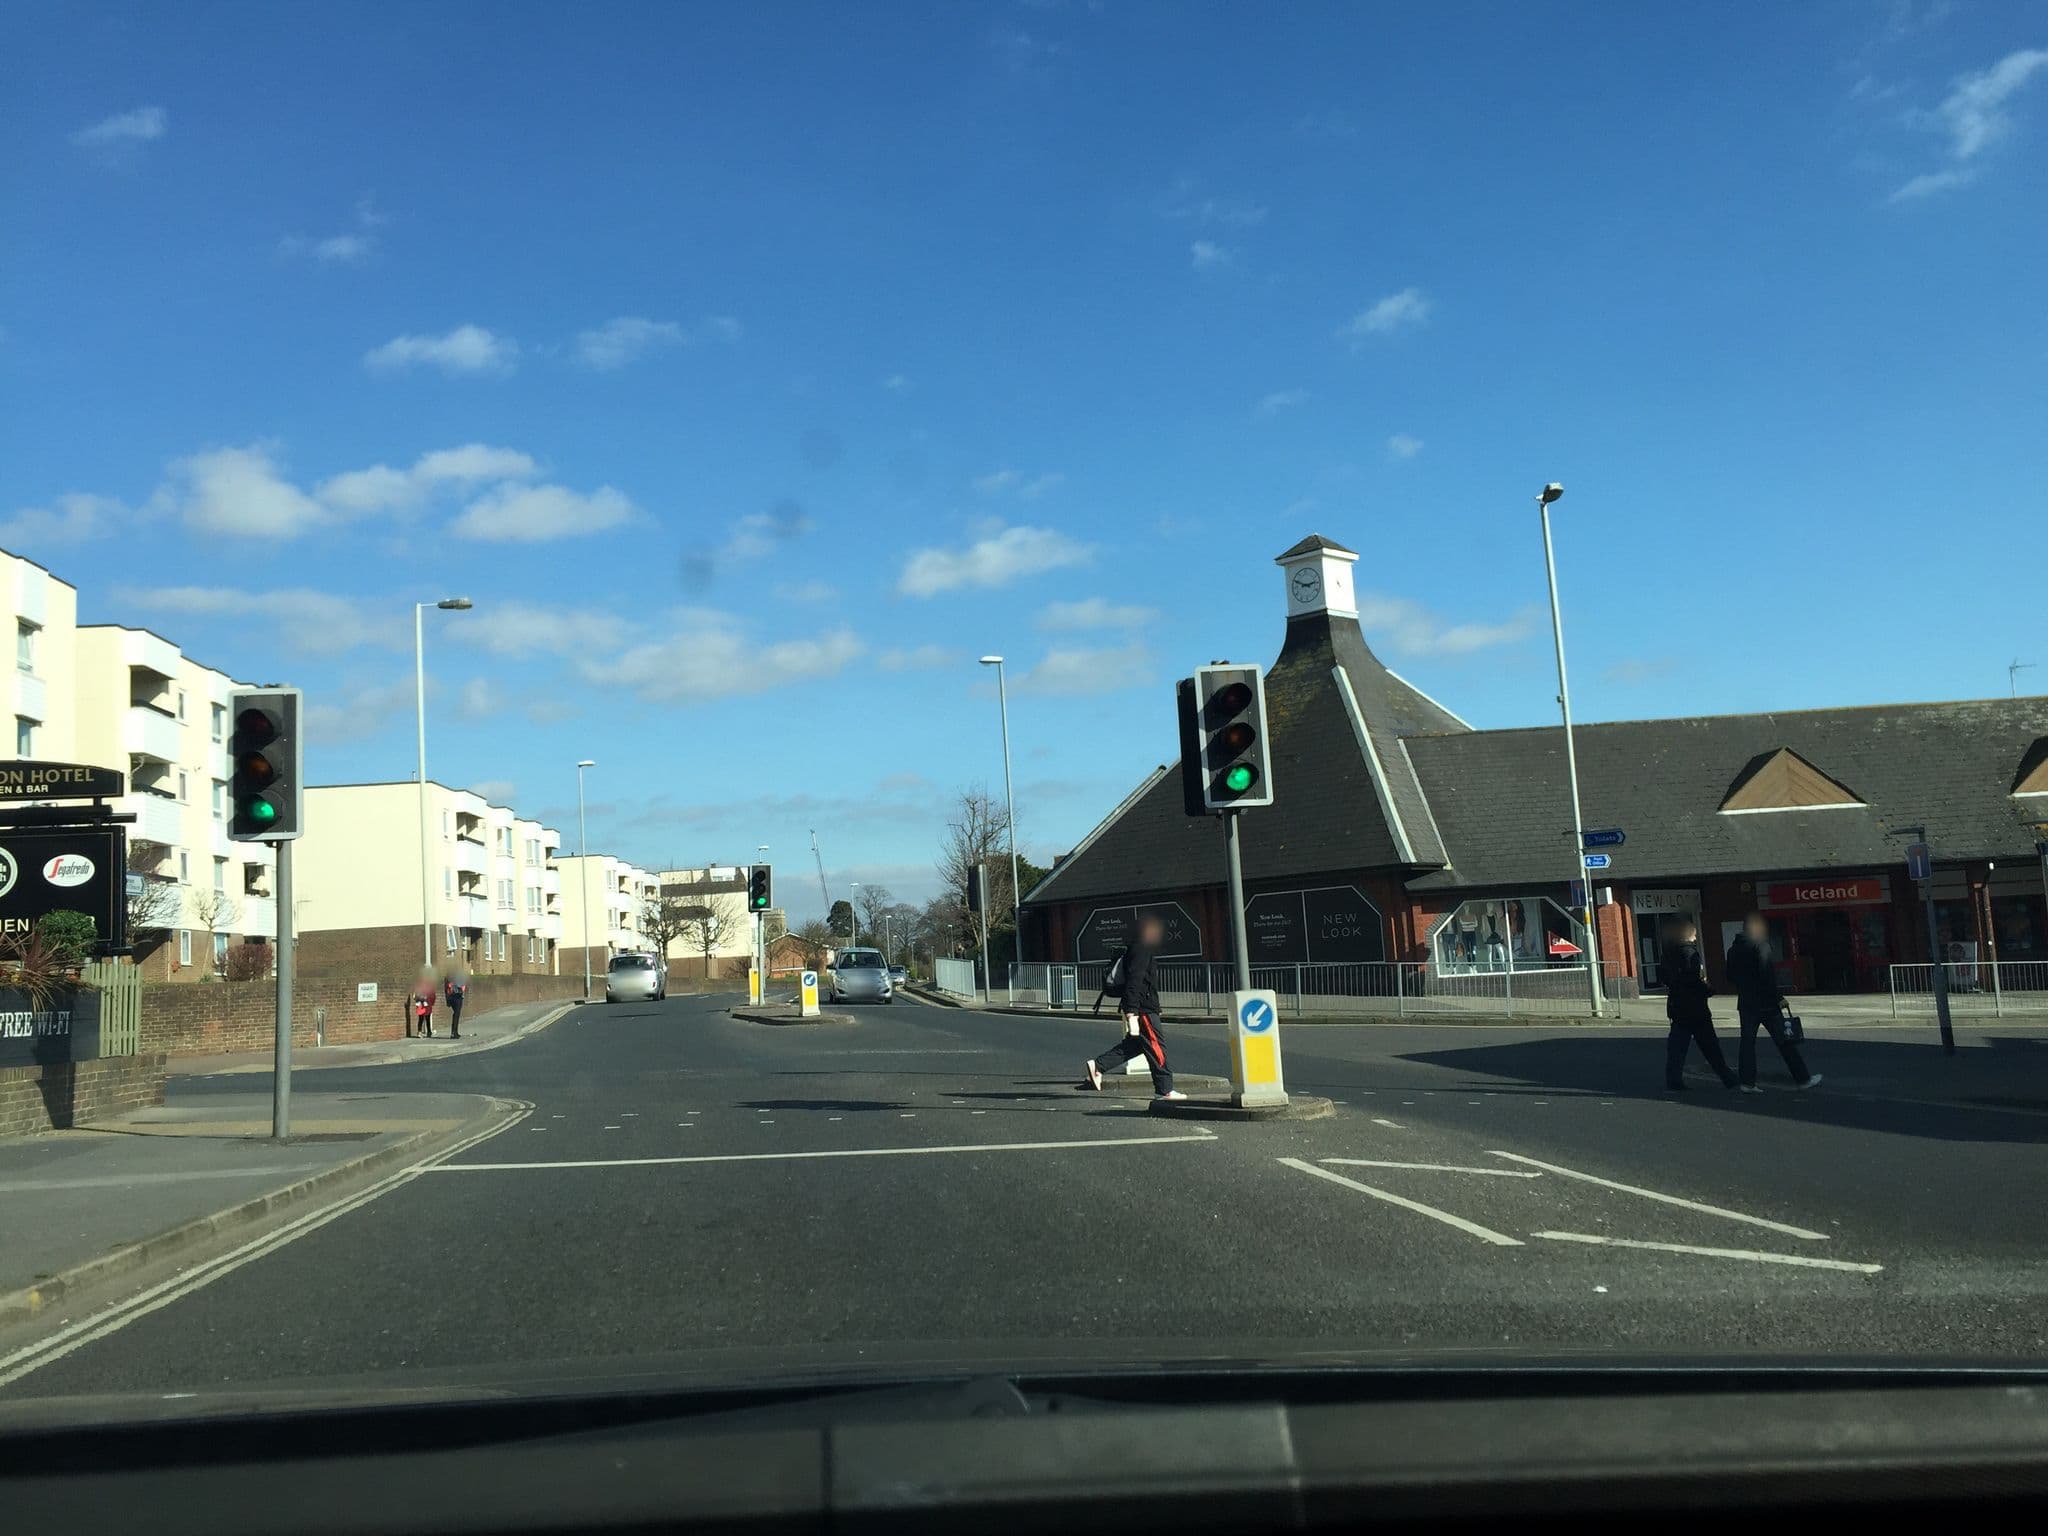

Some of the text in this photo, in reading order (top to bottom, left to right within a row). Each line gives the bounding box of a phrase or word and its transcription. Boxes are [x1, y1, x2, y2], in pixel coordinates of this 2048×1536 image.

[31, 768, 95, 784] HOTEL
[15, 785, 23, 794] &
[26, 784, 48, 793] BAR
[48, 858, 90, 879] Segafredo
[1795, 885, 1858, 901] Iceland
[1635, 894, 1662, 908] NEW
[0, 918, 29, 932] EN
[1322, 912, 1357, 925] NEW
[1321, 926, 1361, 939] LOOK
[36, 1011, 70, 1036] WI-FI
